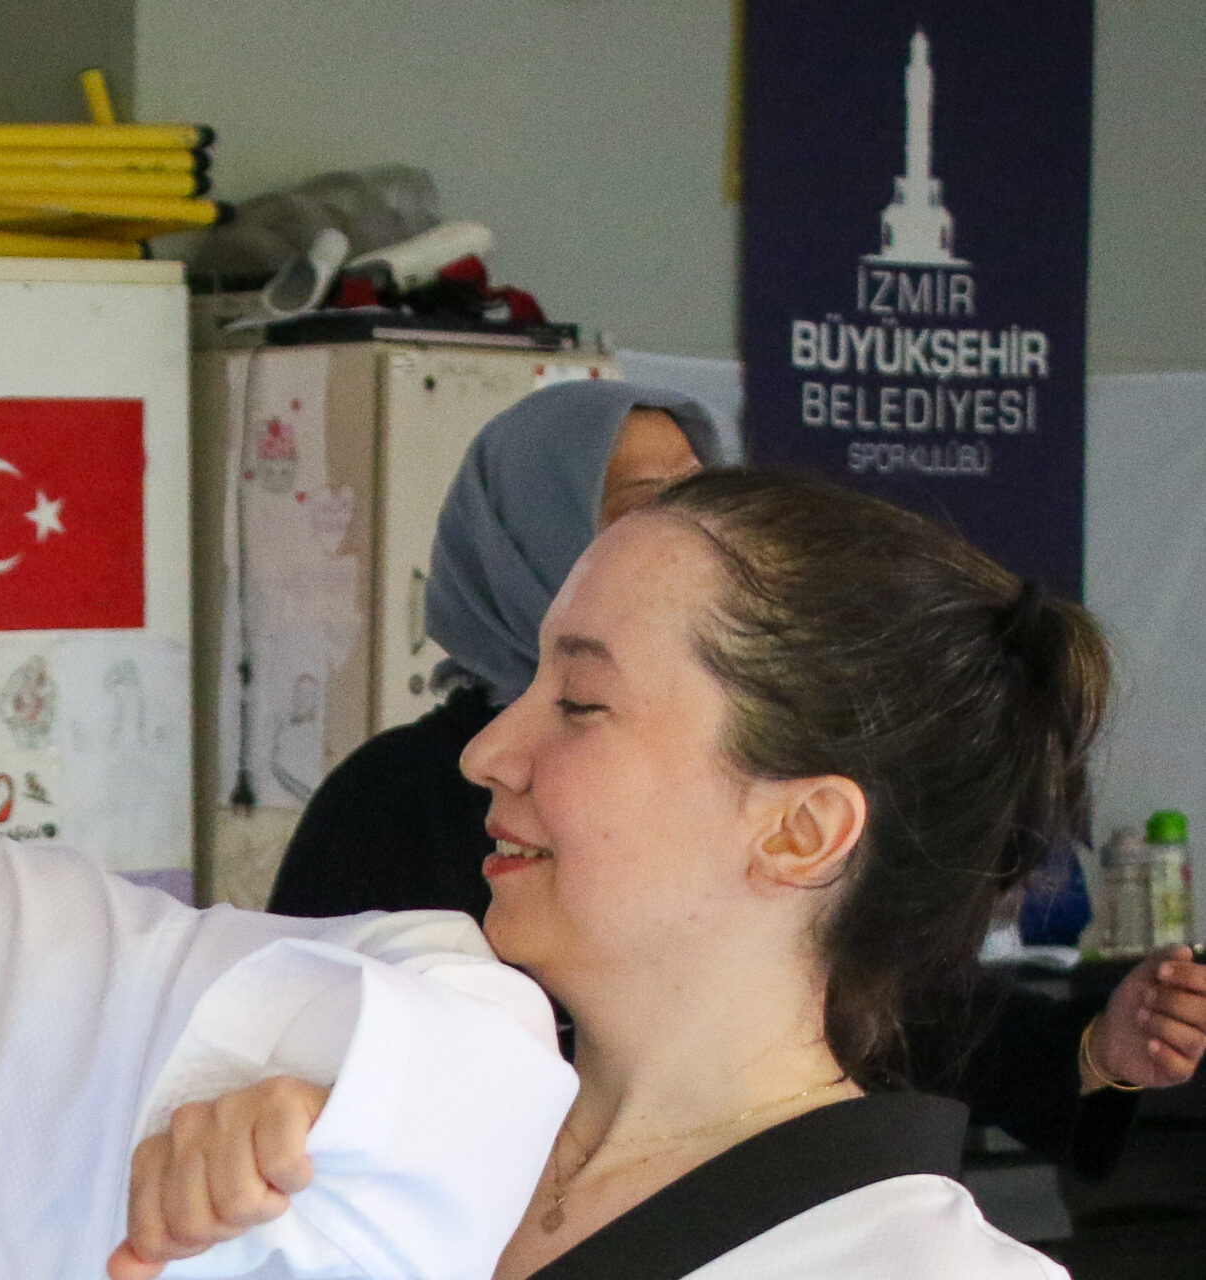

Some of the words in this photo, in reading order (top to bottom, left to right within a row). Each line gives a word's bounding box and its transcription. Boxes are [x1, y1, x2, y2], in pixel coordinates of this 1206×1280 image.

[857, 265, 975, 315] İZMİR
[793, 312, 1049, 380] BÜYÜKŞEHİR
[802, 381, 1036, 433] BELEDİYESİ
